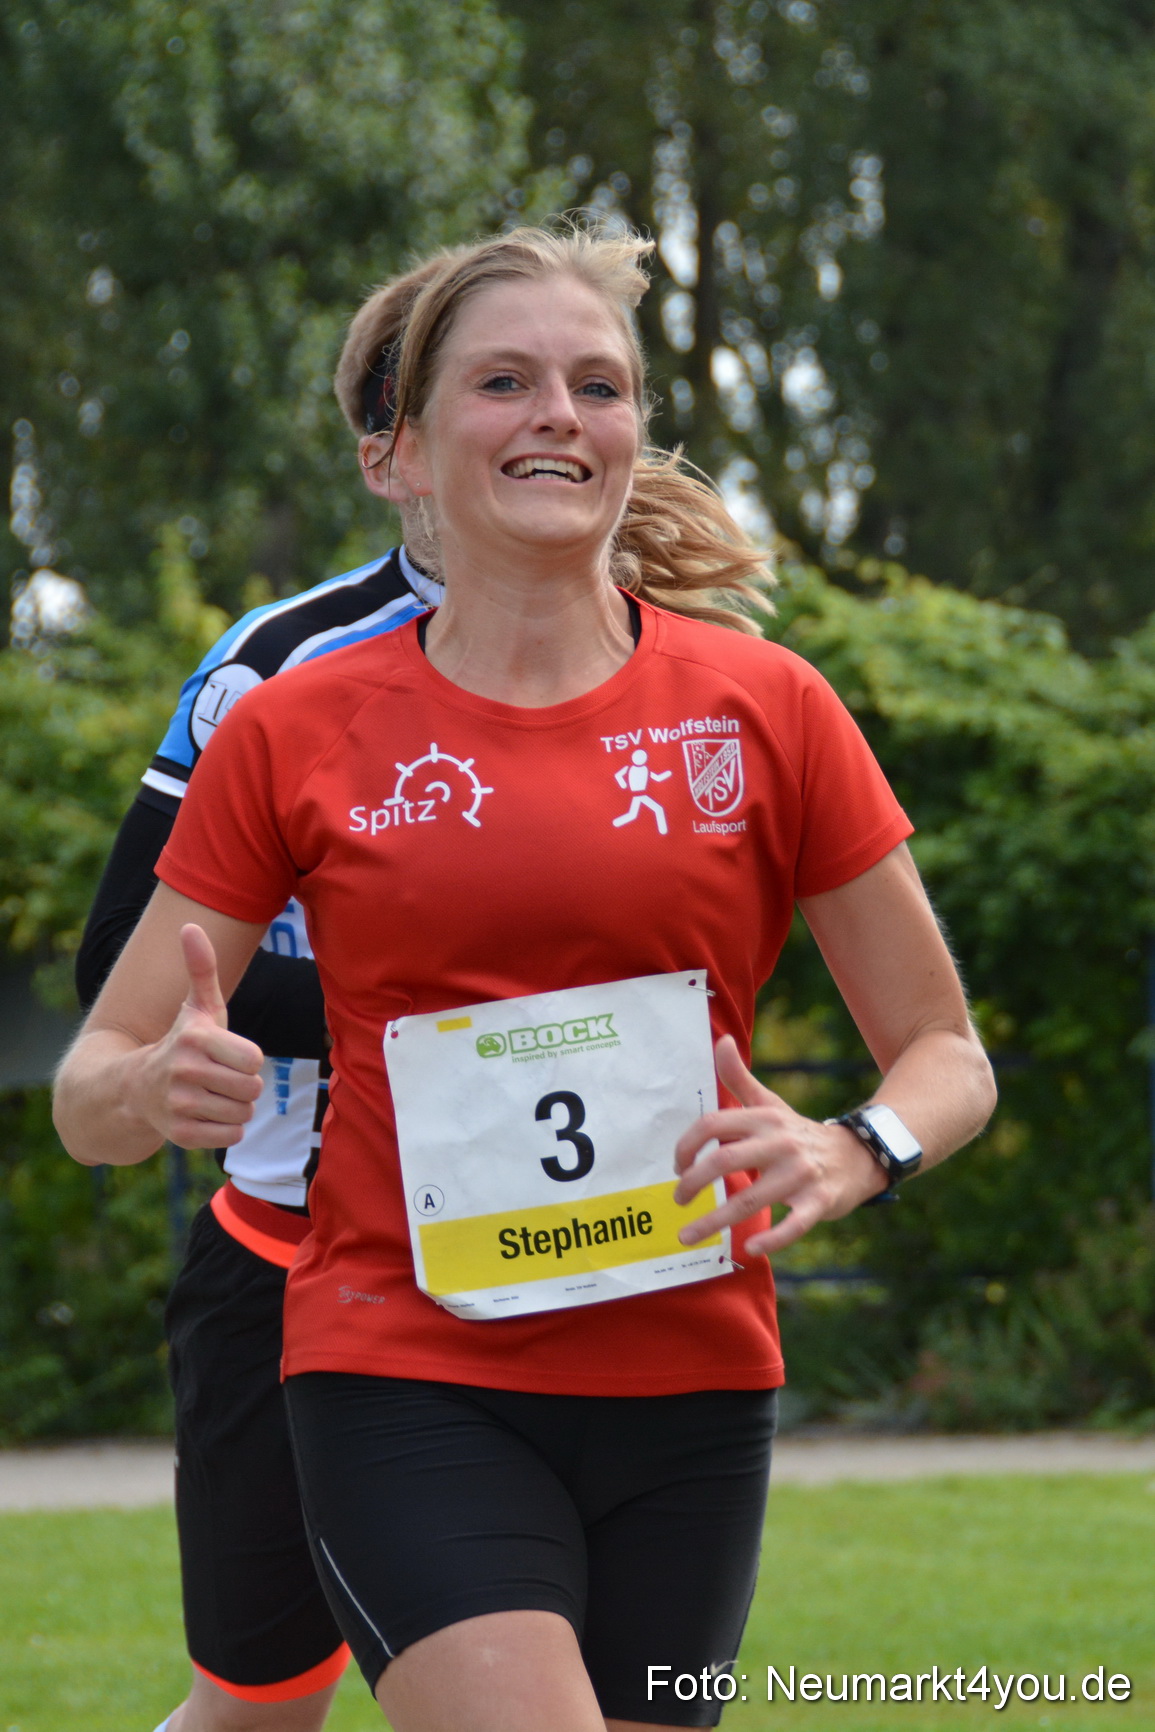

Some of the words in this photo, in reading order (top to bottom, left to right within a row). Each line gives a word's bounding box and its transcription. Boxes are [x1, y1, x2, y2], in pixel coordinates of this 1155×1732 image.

[601, 728, 642, 753] TSV
[648, 715, 739, 743] Wolfstein
[705, 757, 736, 811] TSV
[349, 799, 437, 836] Spitz
[692, 819, 747, 836] Laufsport
[508, 1013, 619, 1054] BOCK
[511, 1052, 545, 1063] inspired
[547, 1050, 558, 1059] by
[560, 1046, 584, 1056] smart
[586, 1039, 622, 1051] concepts
[535, 1090, 595, 1182] 3
[424, 1193, 436, 1210] A
[498, 1206, 653, 1260] Stephanie
